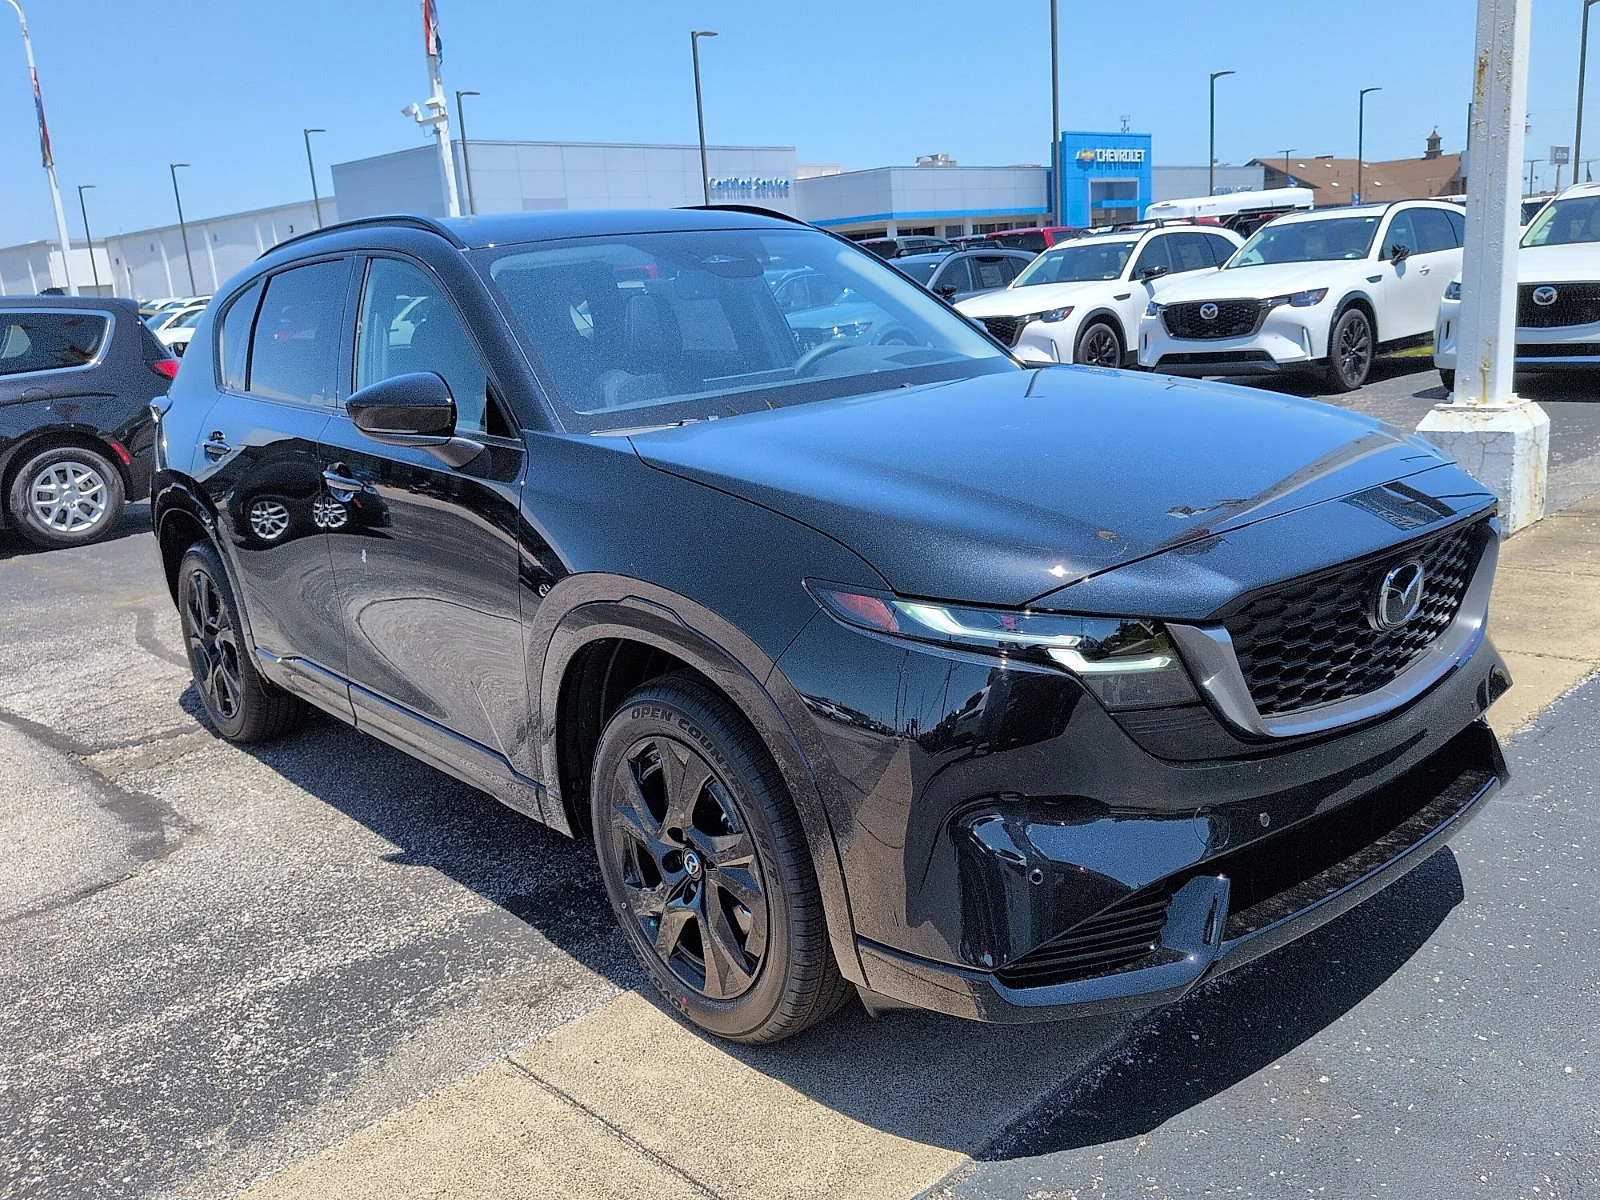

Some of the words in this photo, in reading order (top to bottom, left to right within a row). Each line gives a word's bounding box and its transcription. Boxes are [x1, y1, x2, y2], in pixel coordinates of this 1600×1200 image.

[1094, 148, 1146, 163] CHEVROLET
[709, 177, 752, 191] Certified
[753, 177, 790, 191] Service
[630, 706, 673, 723] OPEN
[677, 718, 755, 810] COUNTRY
[653, 977, 691, 1017] TOYO
